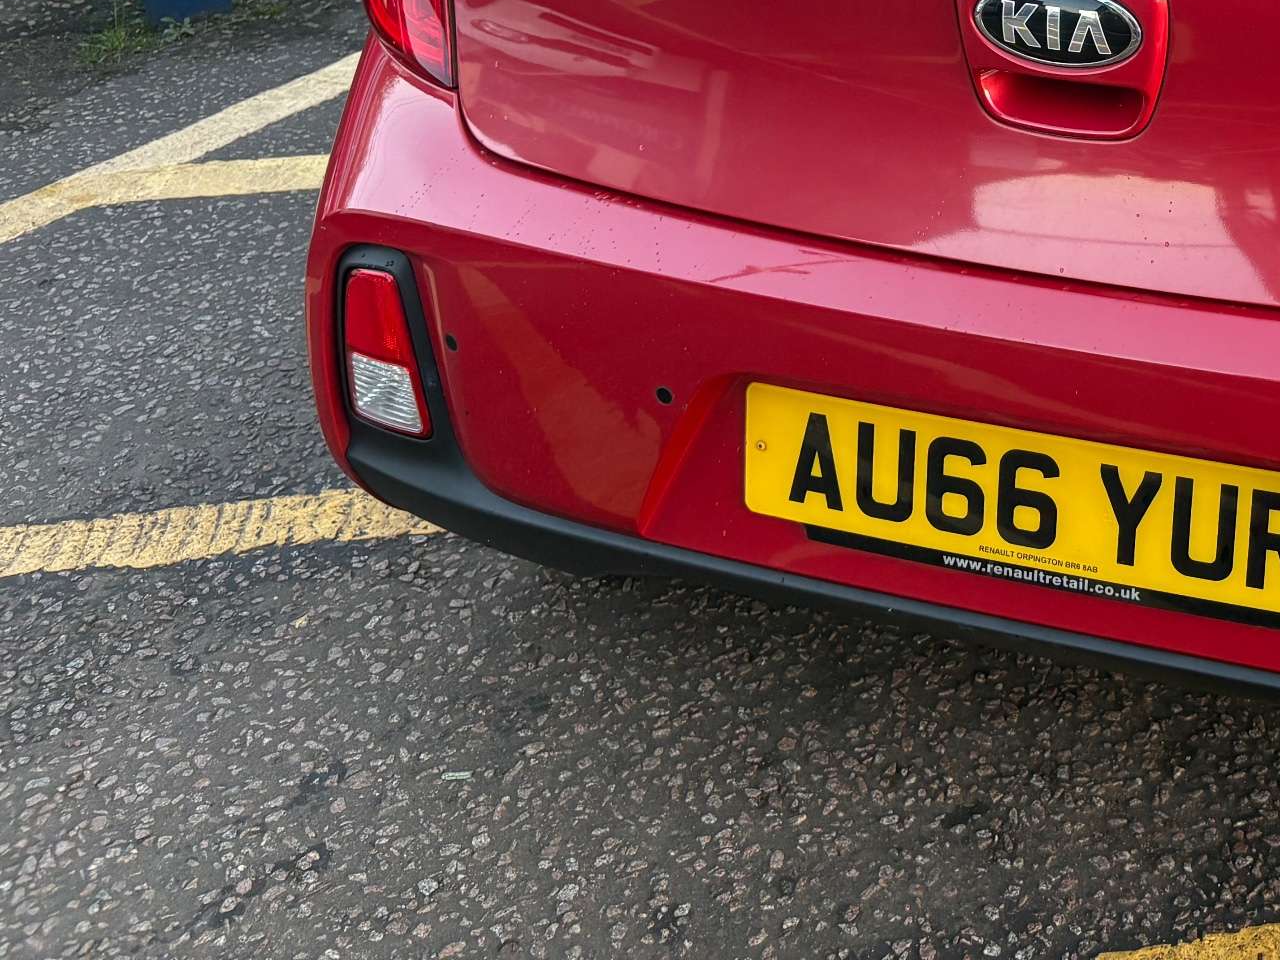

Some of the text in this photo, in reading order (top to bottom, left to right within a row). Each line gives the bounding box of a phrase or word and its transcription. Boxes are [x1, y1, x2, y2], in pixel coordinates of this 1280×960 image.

[1000, 0, 1112, 55] KIA
[789, 411, 1061, 550] AU66
[942, 552, 1141, 603] www.renaultretail.co.uk
[978, 544, 1014, 558] RENAULT
[1016, 552, 1064, 568] ORPINGTON
